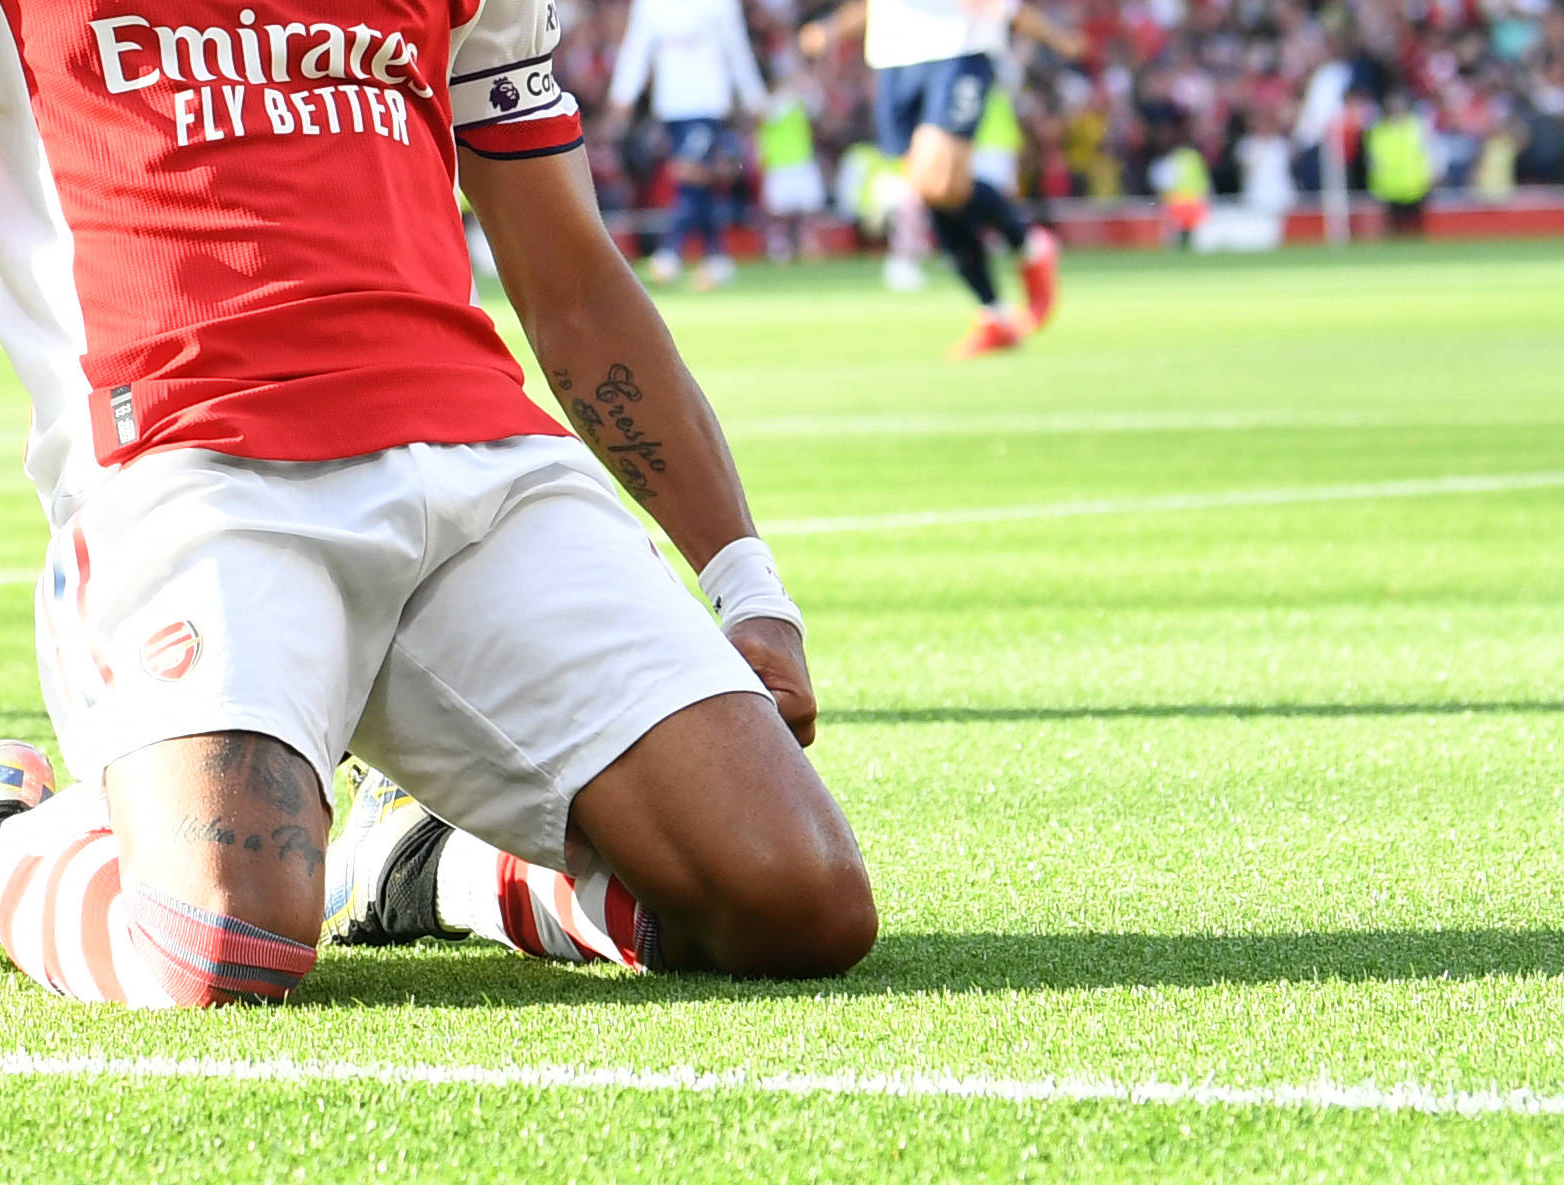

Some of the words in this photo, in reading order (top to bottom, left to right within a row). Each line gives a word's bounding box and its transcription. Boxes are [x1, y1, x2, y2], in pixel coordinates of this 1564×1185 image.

[88, 9, 434, 99] Emirates
[174, 85, 247, 146] FLY
[264, 84, 410, 146] BETTER
